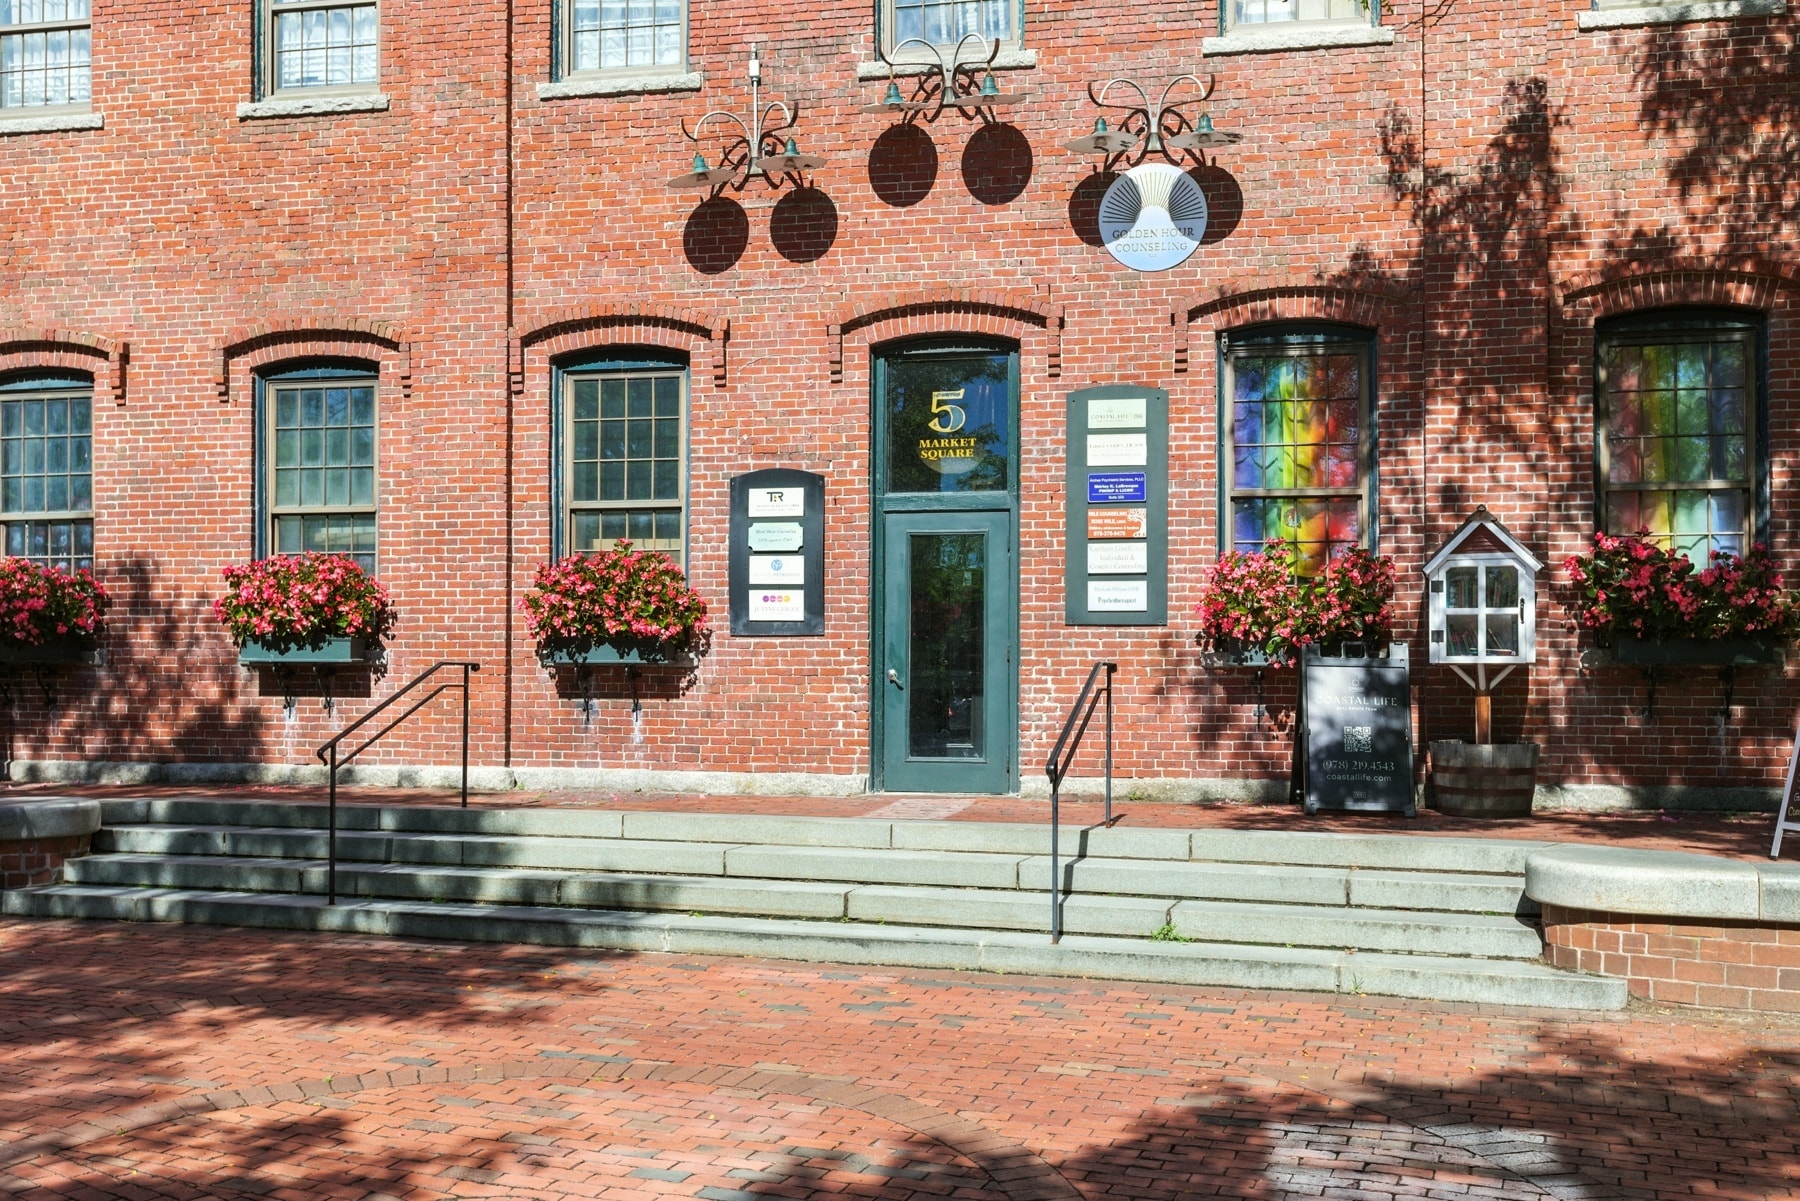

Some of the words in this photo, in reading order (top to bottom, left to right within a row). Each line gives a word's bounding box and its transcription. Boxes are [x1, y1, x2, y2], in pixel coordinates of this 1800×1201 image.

[1112, 228, 1158, 239] GOLDEN
[1161, 227, 1194, 238] HOUR
[1115, 241, 1188, 253] COUNSELING
[927, 388, 966, 433] 5
[919, 437, 977, 448] MARKET
[920, 448, 974, 460] SQUARE
[1089, 562, 1113, 570] Couples
[1113, 562, 1145, 570] Counseling
[1097, 596, 1137, 604] Psychotherapist
[1315, 695, 1370, 706] COASTAL
[1374, 697, 1398, 706] LIFE
[1322, 760, 1349, 771] (978)
[1351, 761, 1395, 772] 219.4543
[1326, 774, 1392, 782] coastallife.com
